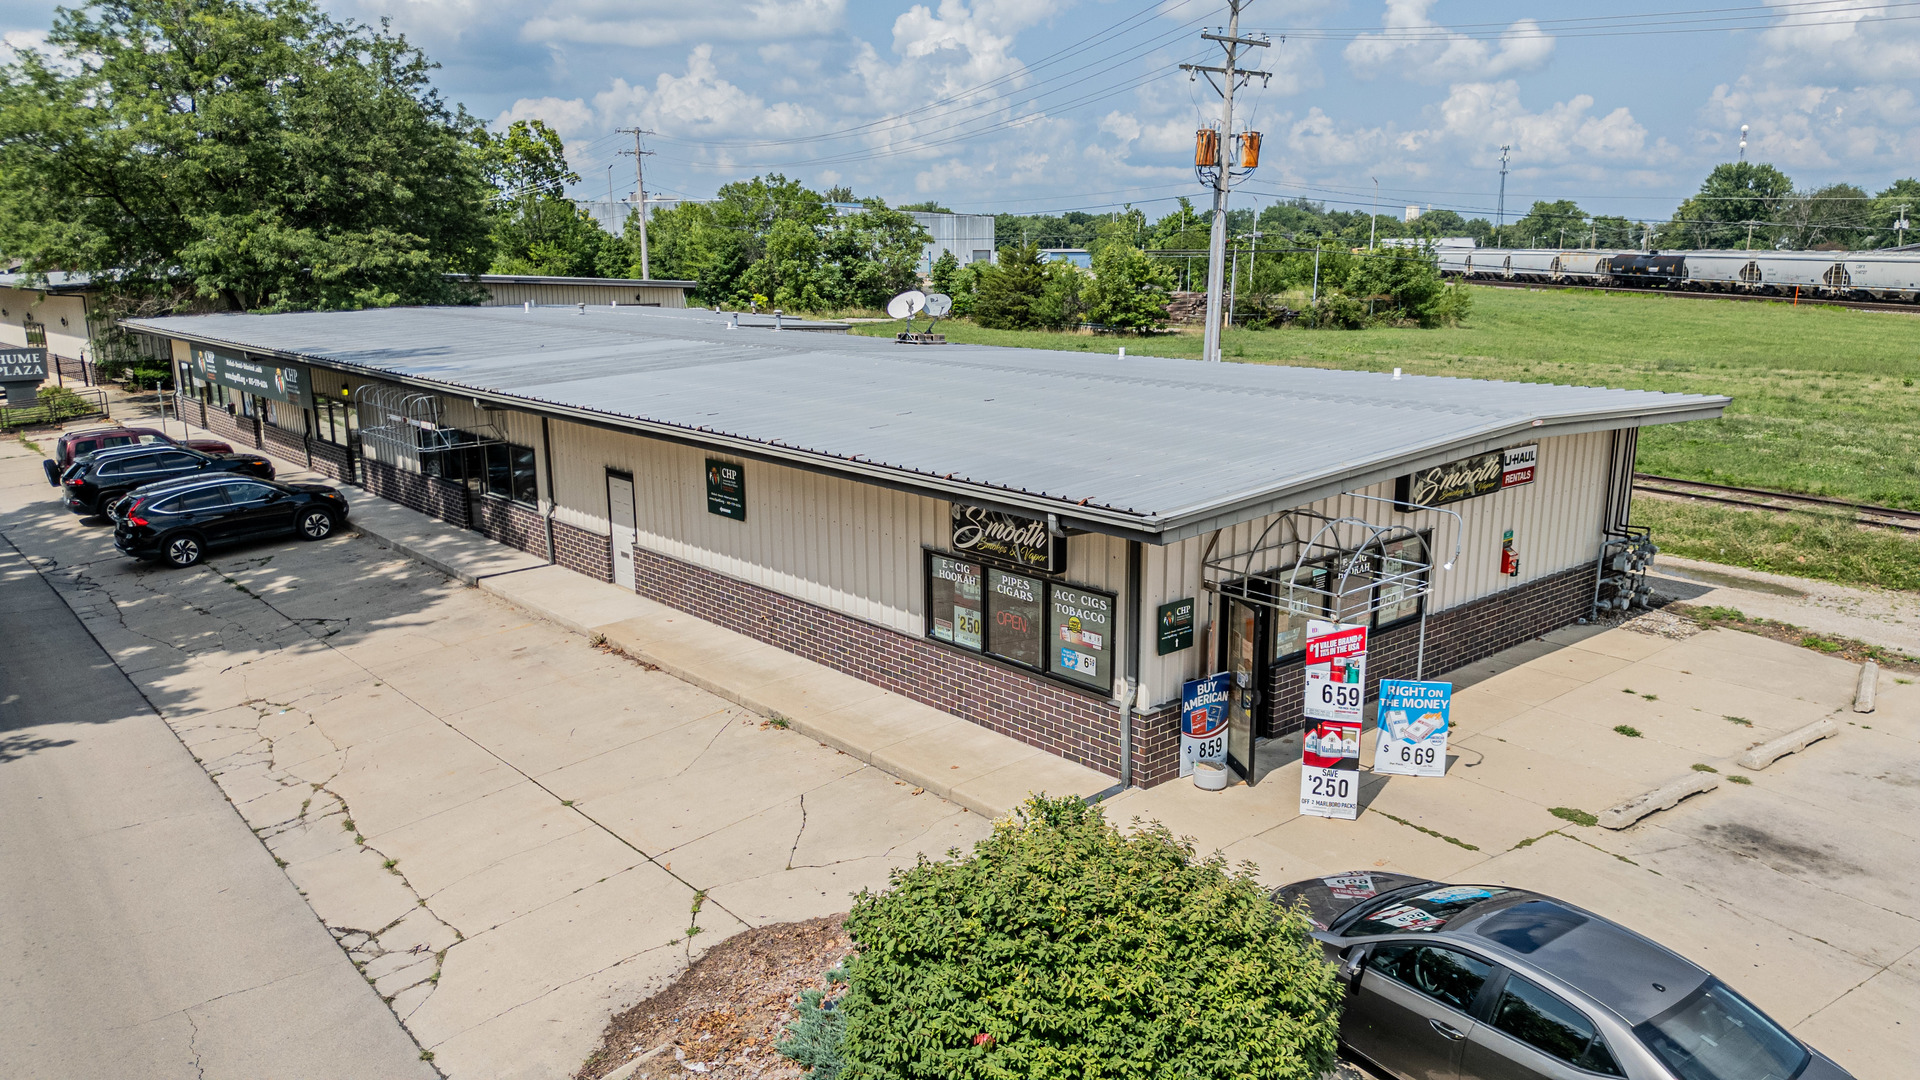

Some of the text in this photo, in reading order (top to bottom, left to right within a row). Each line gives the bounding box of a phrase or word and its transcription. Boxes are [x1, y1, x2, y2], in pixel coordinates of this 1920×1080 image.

[284, 367, 298, 383] CHP
[1504, 450, 1535, 466] U-HAUL
[721, 467, 737, 480] CHP
[1415, 456, 1501, 506] Smooth
[1505, 470, 1531, 484] RENTALS
[953, 506, 1047, 549] Smooth
[977, 536, 1048, 564] Smokes & Vapor
[939, 569, 976, 586] HOOKAH
[1001, 575, 1030, 590] PIPES
[996, 584, 1034, 602] CIGARS
[1054, 589, 1107, 611] ACC CIGS
[1054, 602, 1105, 624] TOBACCO
[1176, 605, 1191, 616] CHP
[996, 610, 1027, 633] OPEN
[1309, 642, 1320, 658] #1
[1320, 639, 1338, 649] VALUE
[1337, 645, 1347, 654] THE
[1347, 642, 1360, 651] USA
[1197, 681, 1218, 696] BUY
[1387, 685, 1443, 698] RIGHT ON
[1183, 690, 1229, 713] AMERICAN
[1380, 698, 1449, 709] THE MONEY
[1187, 745, 1192, 754] $
[1383, 744, 1389, 753] $
[1322, 768, 1339, 778] SAVE
